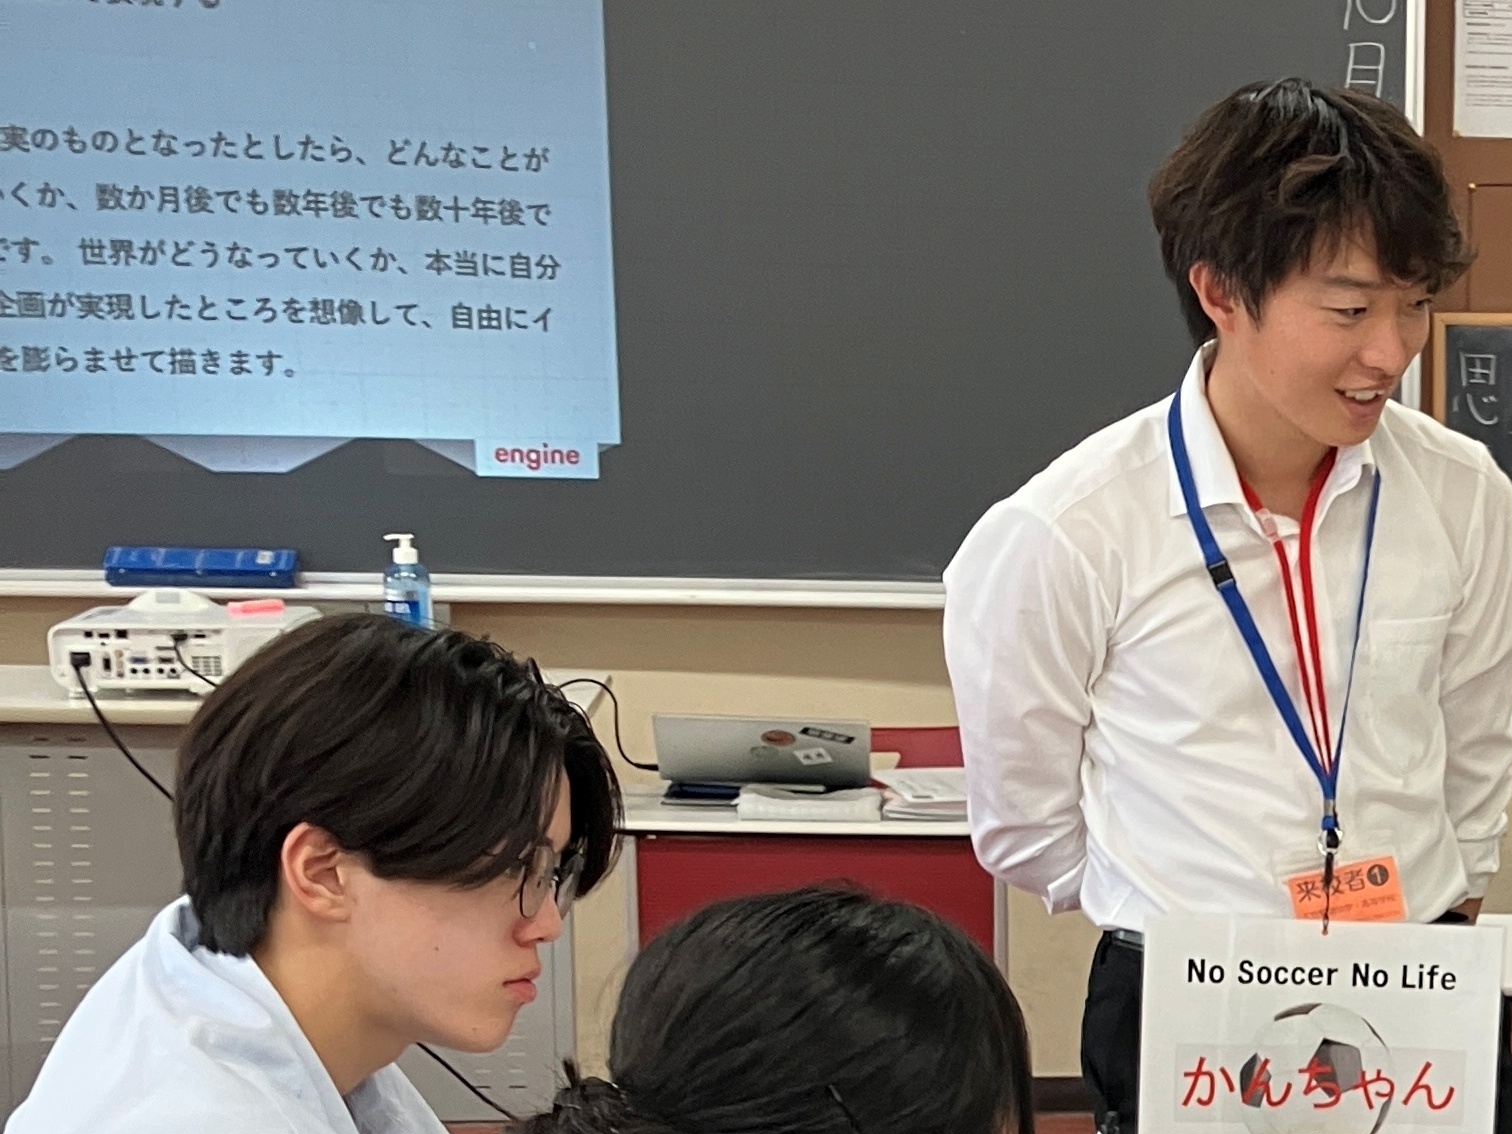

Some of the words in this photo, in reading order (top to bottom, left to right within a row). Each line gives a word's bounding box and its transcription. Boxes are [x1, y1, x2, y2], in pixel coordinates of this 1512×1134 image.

[0, 124, 550, 174] 実のものとなったとしたら、どんなことが
[0, 181, 551, 229] くか、数か月後でも数年後でも数十年後で
[494, 444, 580, 470] engine
[1187, 958, 1225, 984] No
[1237, 960, 1339, 986] Soccer
[1352, 963, 1389, 988] No
[1401, 964, 1457, 990] Life
[1182, 1056, 1455, 1110] かんちゃん
